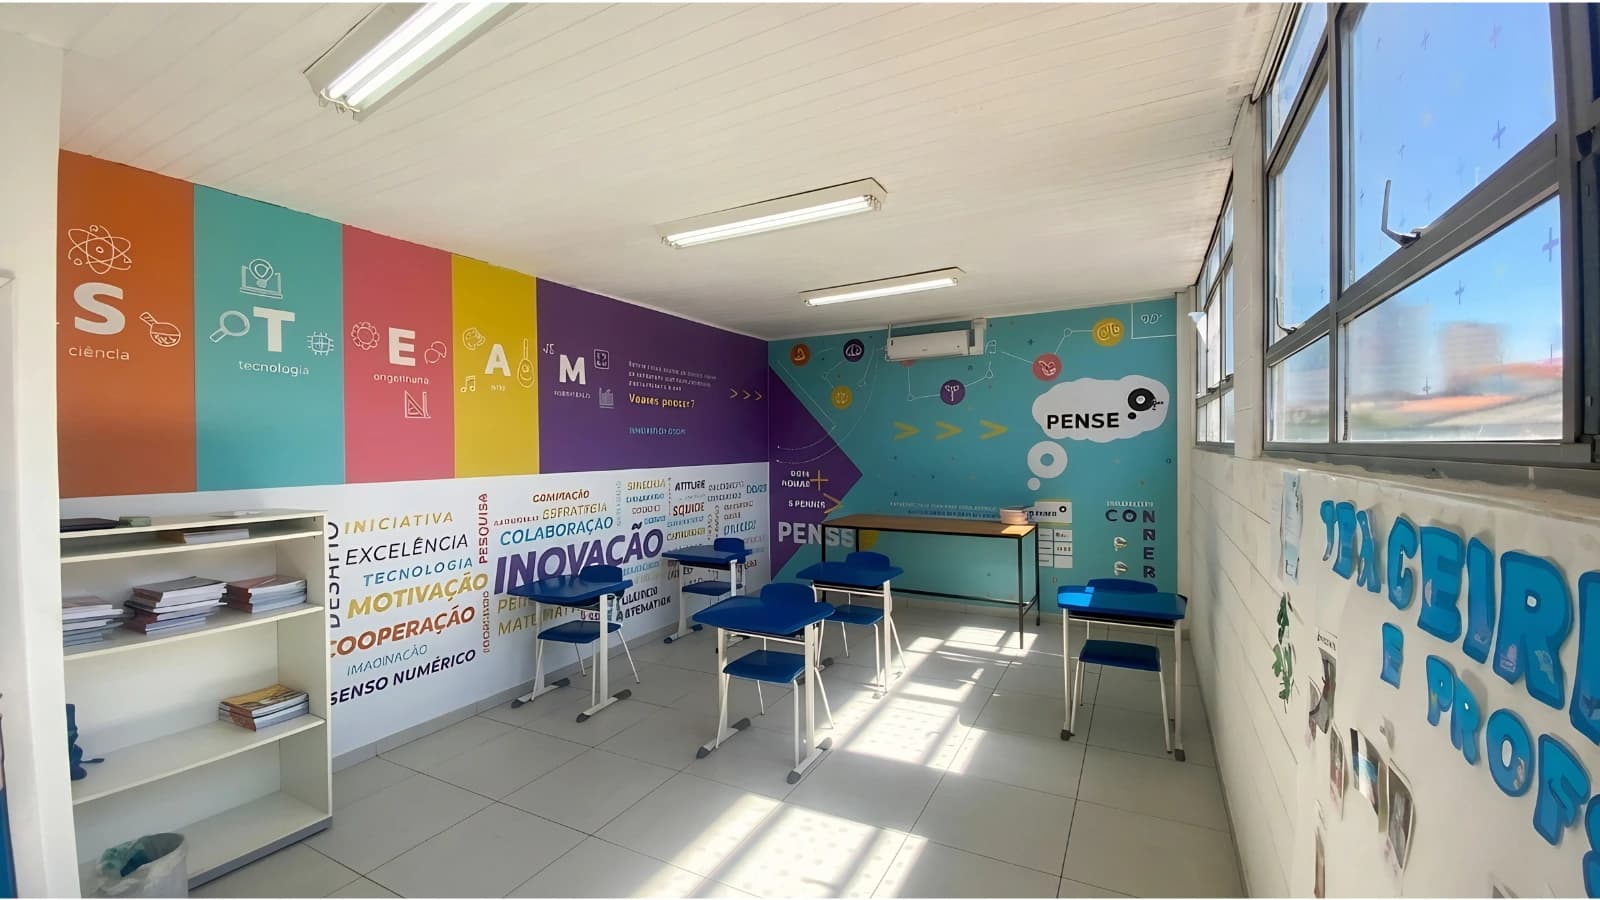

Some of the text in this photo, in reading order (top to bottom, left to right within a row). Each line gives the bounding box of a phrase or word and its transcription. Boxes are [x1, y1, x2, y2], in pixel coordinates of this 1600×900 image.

[74, 282, 126, 335] S
[253, 306, 295, 352] T
[68, 344, 130, 361] ciência
[388, 327, 416, 367] E
[484, 343, 511, 377] A
[238, 360, 310, 377] tecnologia
[559, 354, 586, 385] M
[1047, 412, 1119, 429] PENSE
[344, 511, 453, 534] INICIATIVA
[478, 493, 489, 564] PESQUISA
[345, 533, 468, 565] EXCELÊNCIA
[363, 557, 473, 587] TECNOLOGIA
[347, 572, 489, 619] MOTIVAÇÃO
[393, 649, 476, 685] NUMÉRICO
